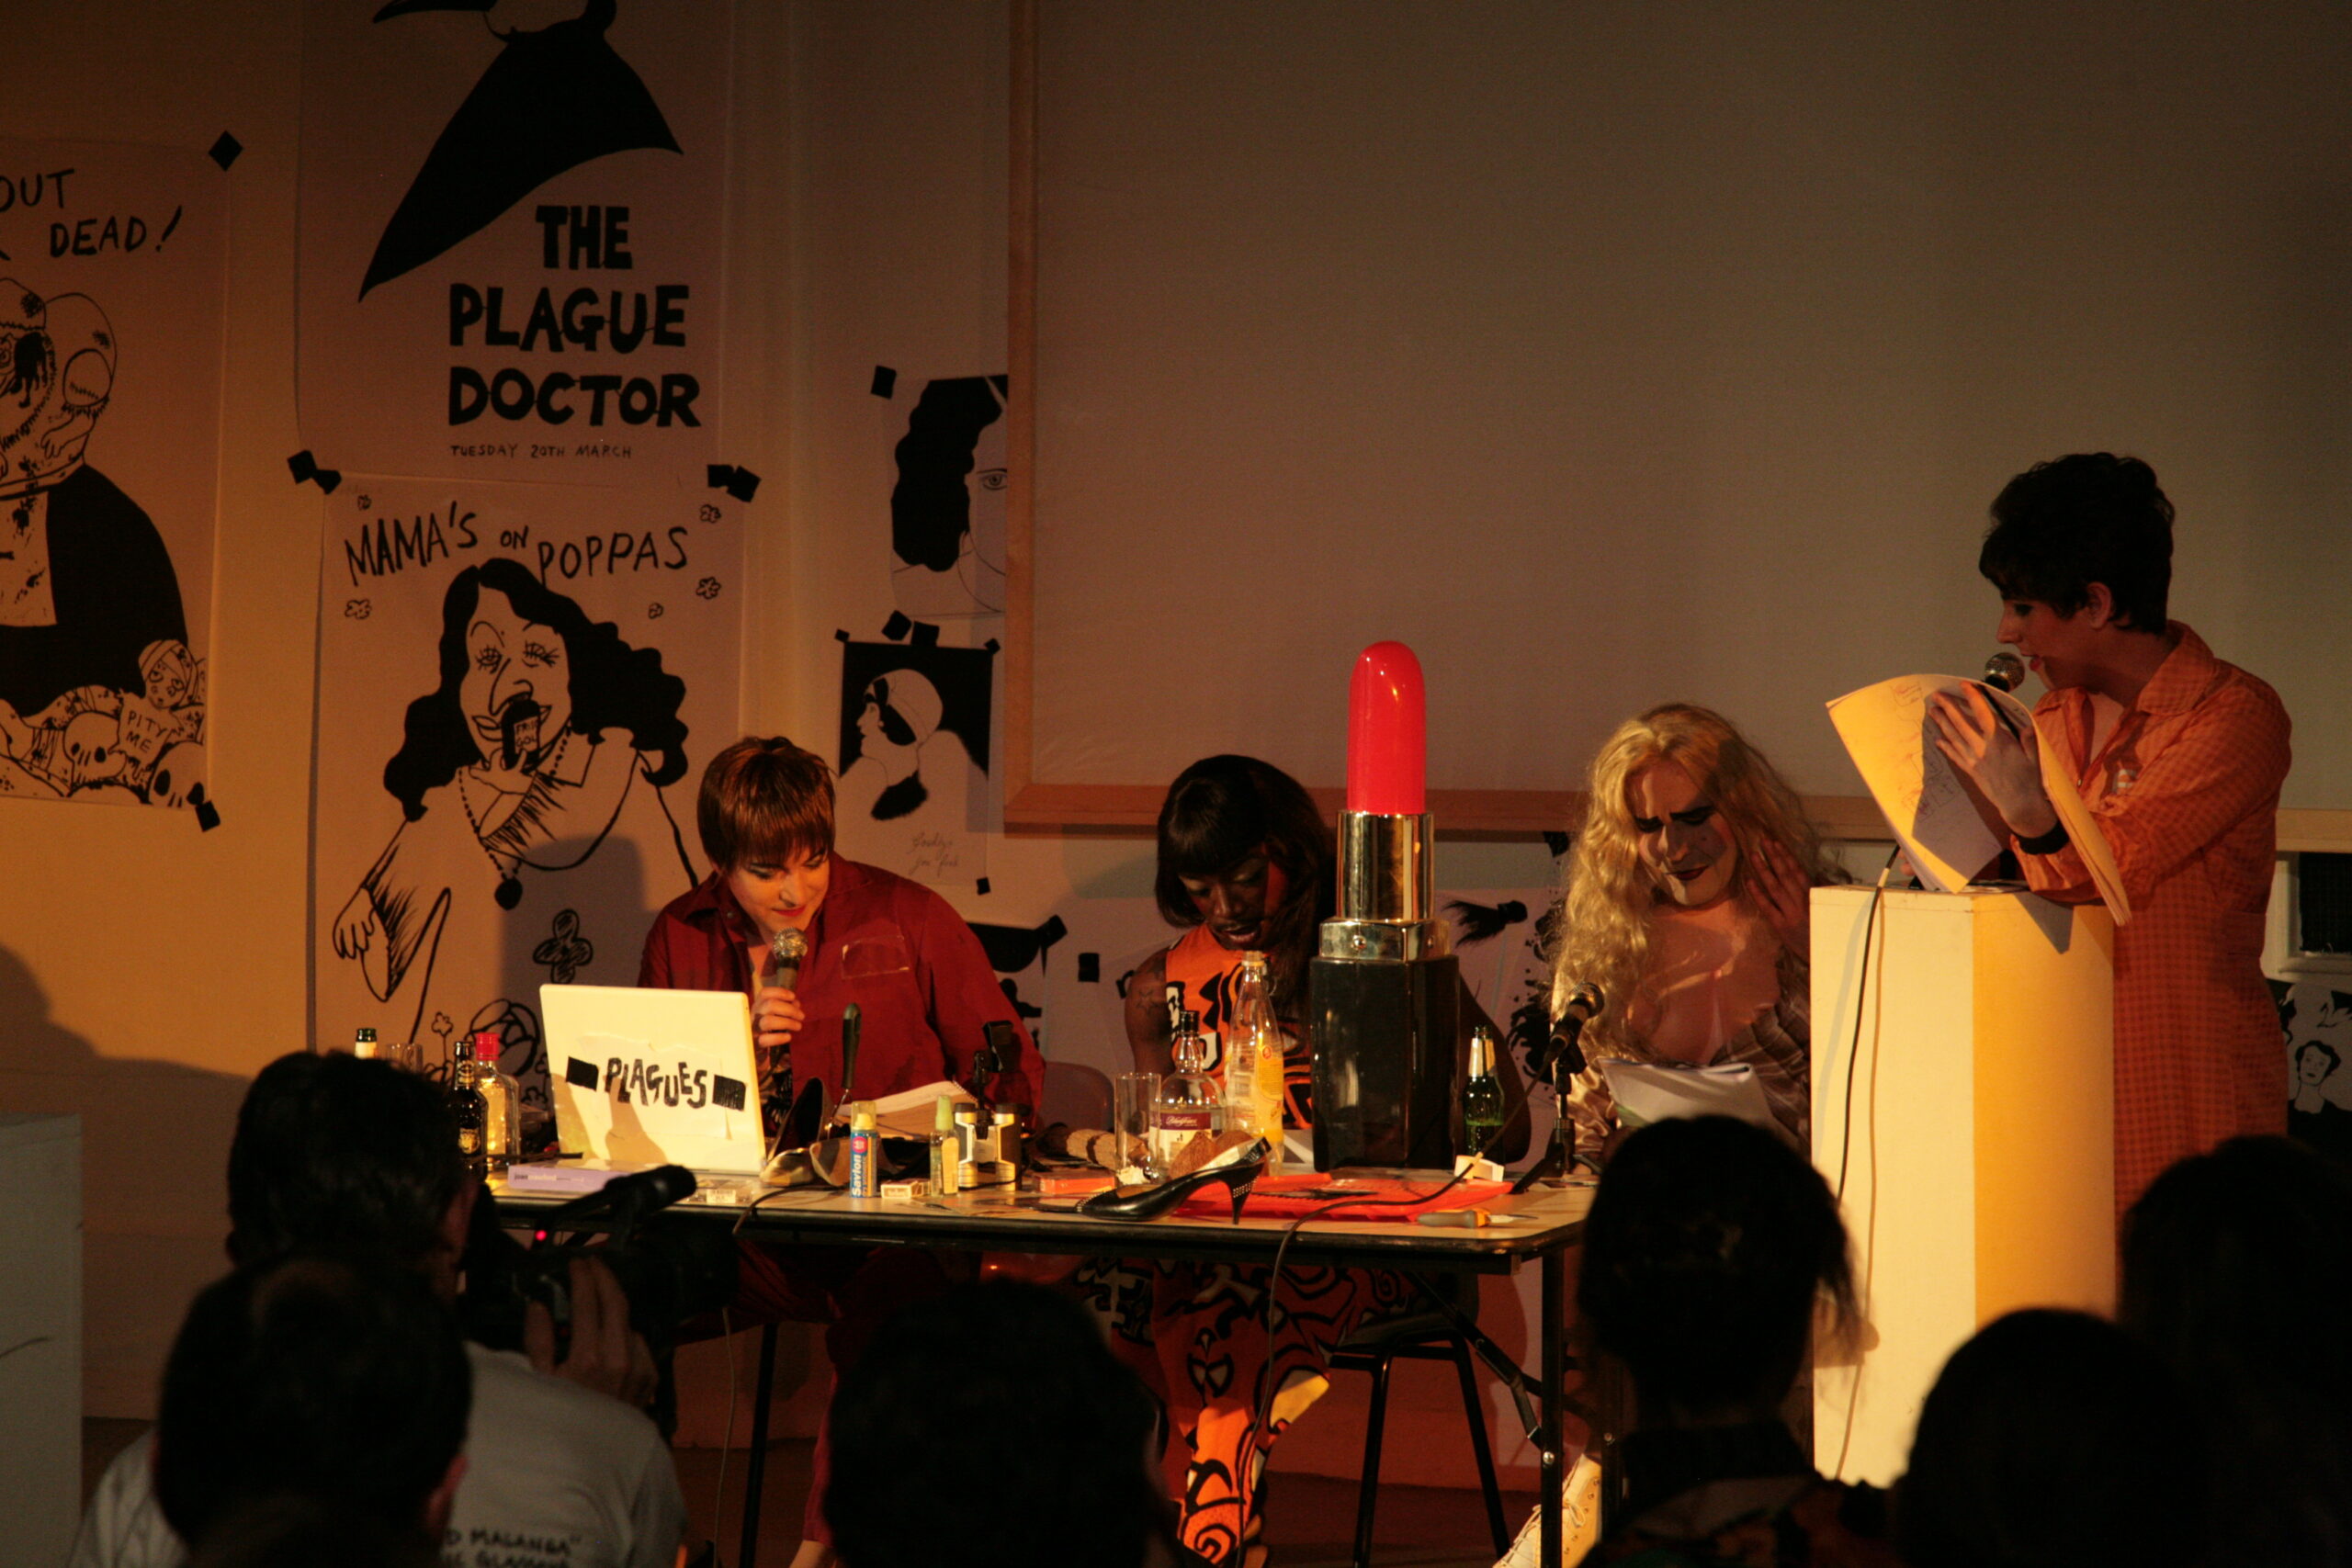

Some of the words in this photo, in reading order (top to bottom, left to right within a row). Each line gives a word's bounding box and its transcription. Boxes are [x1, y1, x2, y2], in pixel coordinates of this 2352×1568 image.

[50, 205, 182, 258] DEAD!
[536, 205, 632, 270] THE
[449, 283, 689, 354] PLAGUE
[448, 367, 701, 427] DOCTOR
[450, 444, 518, 457] TUESDAY
[531, 445, 565, 457] 20TH
[575, 445, 632, 458] MARCH
[344, 501, 478, 586] MAMA'S
[537, 526, 688, 589] POPPAS
[126, 731, 153, 752] ME
[128, 710, 167, 737] PITY
[604, 1056, 707, 1109] PLAGUES
[852, 1155, 862, 1196] Savlon
